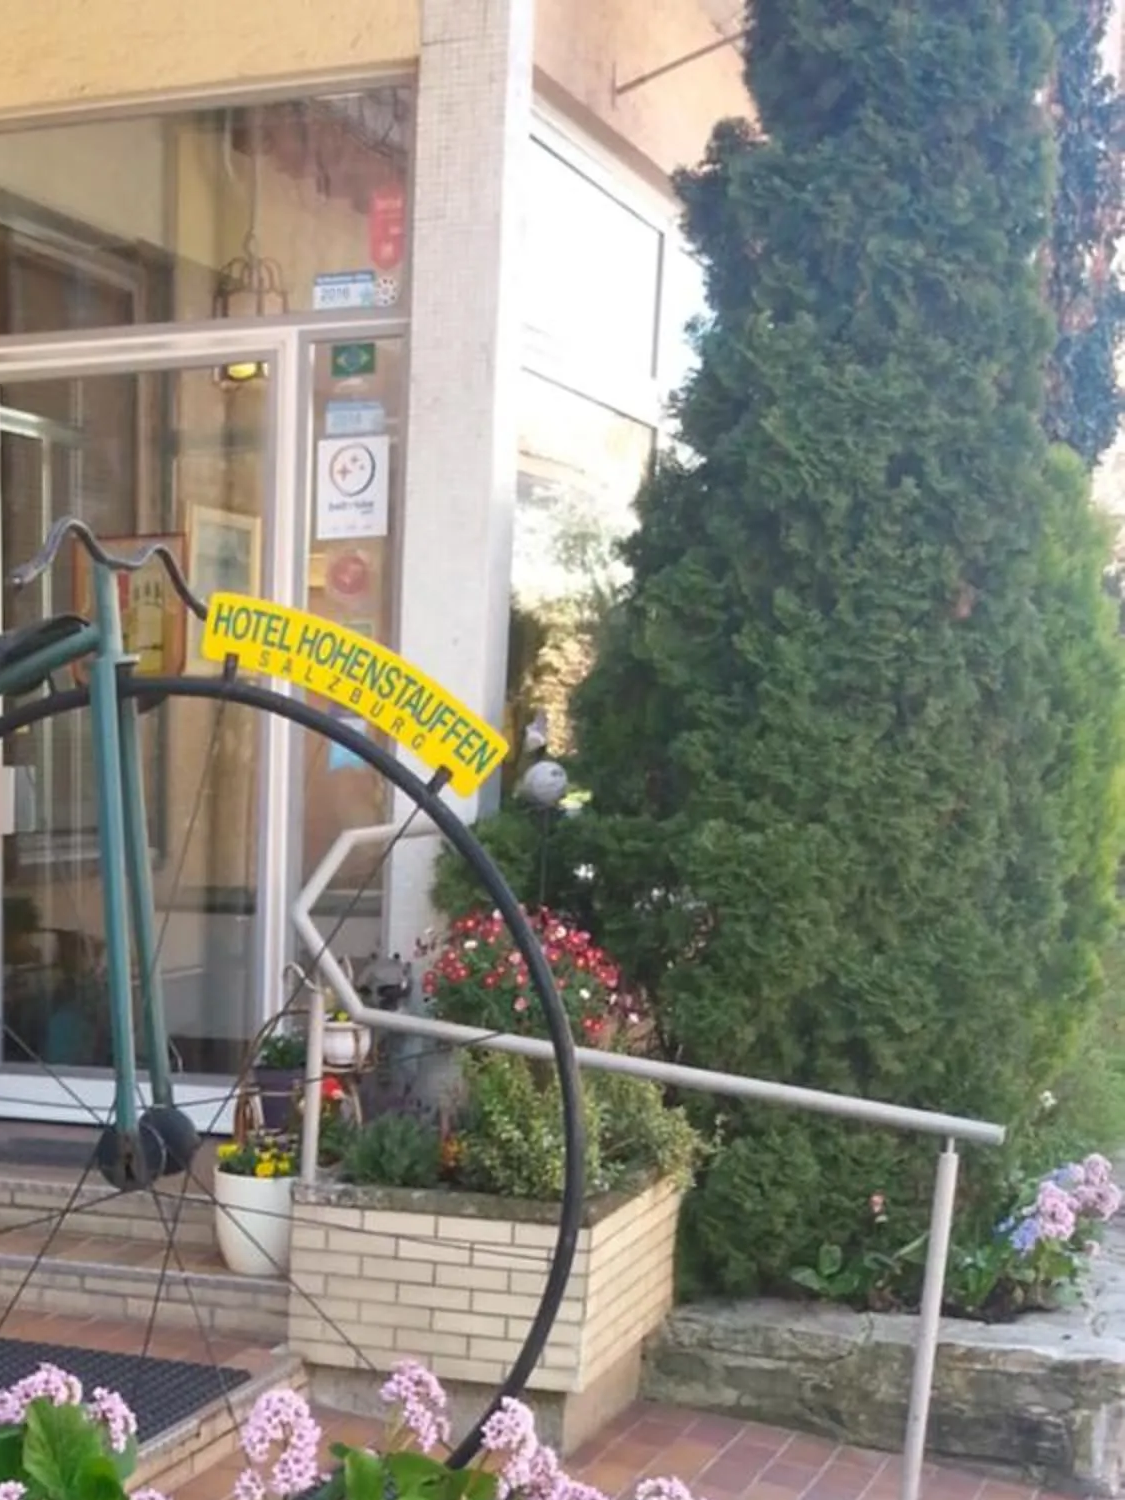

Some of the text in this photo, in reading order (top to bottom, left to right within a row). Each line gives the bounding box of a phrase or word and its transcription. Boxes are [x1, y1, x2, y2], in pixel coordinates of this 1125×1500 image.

[213, 604, 497, 774] HOTEL HOHENSTAUFFEN
[259, 651, 425, 750] SALZBURG
